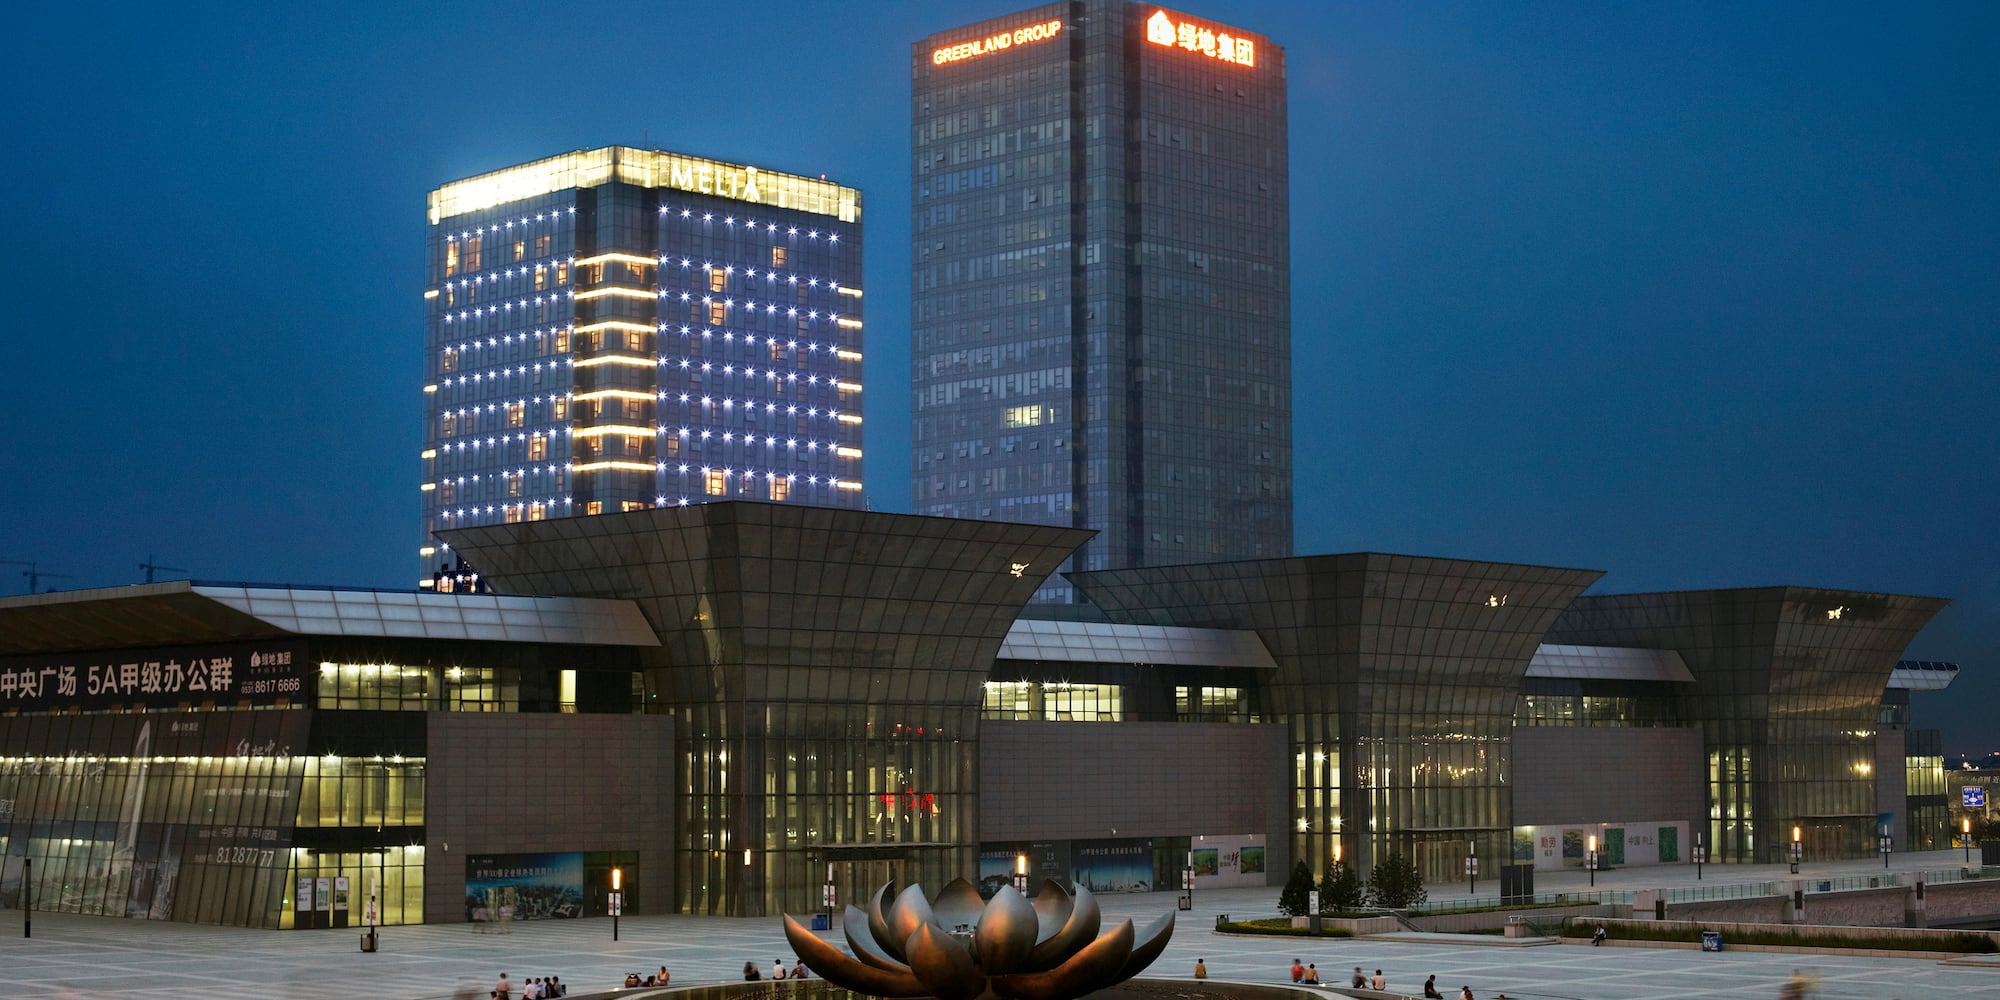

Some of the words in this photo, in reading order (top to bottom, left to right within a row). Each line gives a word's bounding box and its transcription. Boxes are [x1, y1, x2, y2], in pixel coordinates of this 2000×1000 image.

[933, 32, 1012, 65] GREENLAND
[1013, 20, 1062, 45] GROUP
[1177, 22, 1254, 67] 绿地集团
[0, 665, 77, 699] 中央广场
[87, 657, 233, 696] 5A甲级办公群
[255, 680, 275, 694] 8617
[277, 678, 300, 692] 6666
